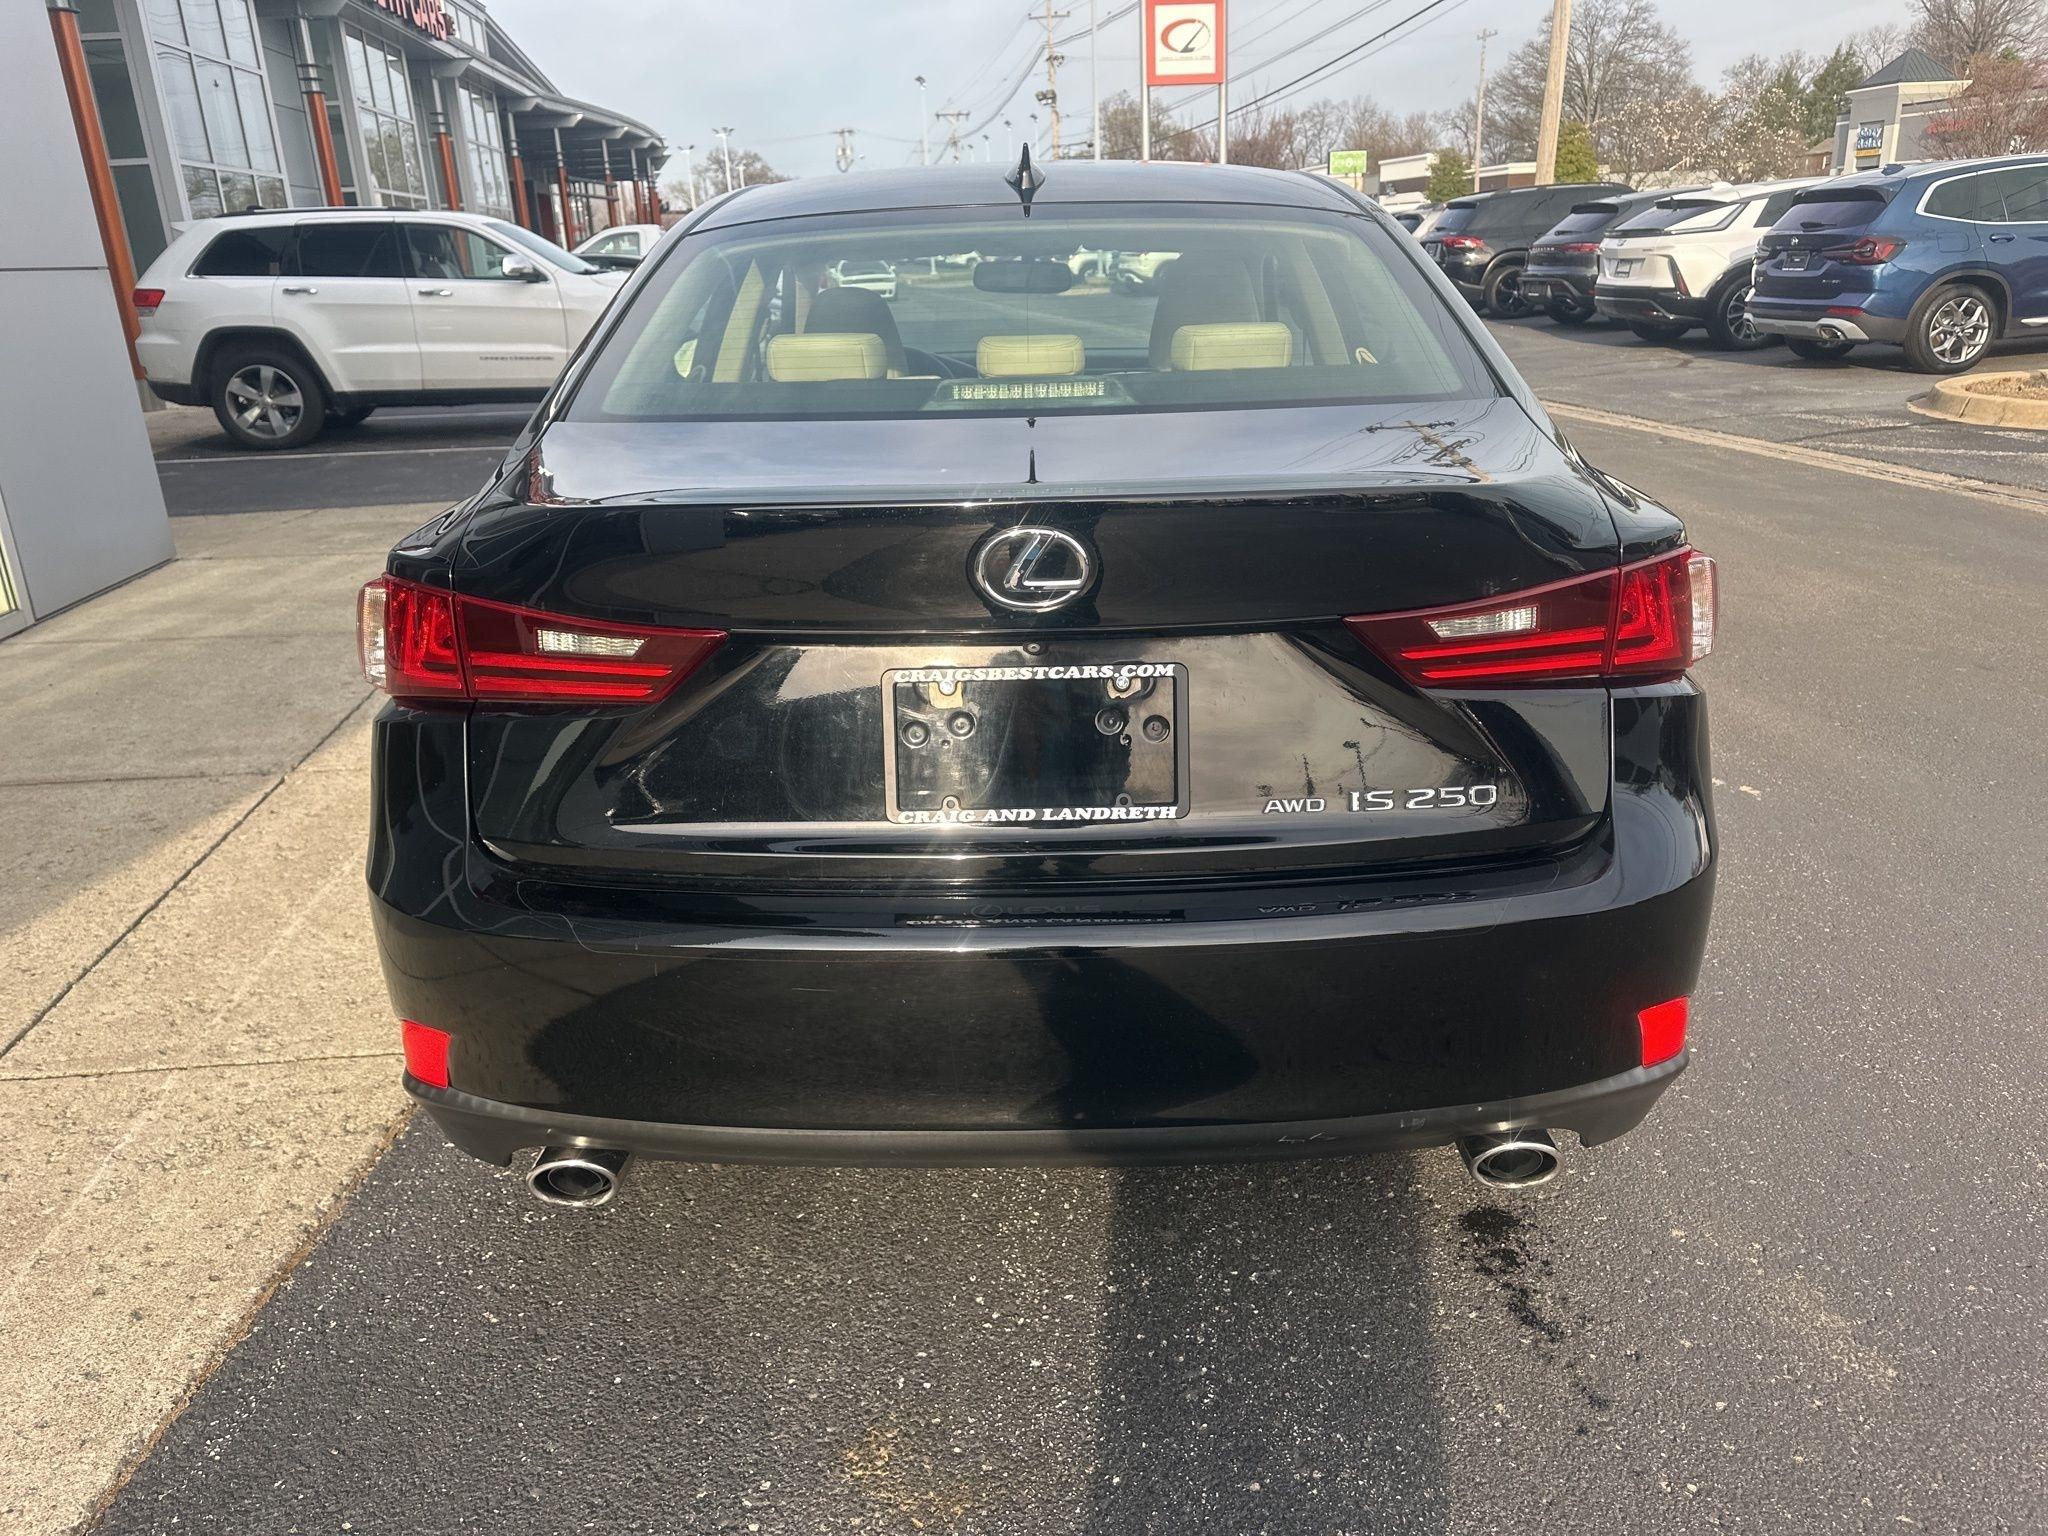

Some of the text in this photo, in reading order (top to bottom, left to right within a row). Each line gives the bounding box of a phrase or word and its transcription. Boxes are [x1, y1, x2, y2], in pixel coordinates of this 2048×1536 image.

[893, 664, 1176, 682] CRAIGSBESTCARS.COM
[1263, 785, 1498, 814] AWD IS 250
[897, 806, 1179, 824] CRAIG AND LANDRETH
